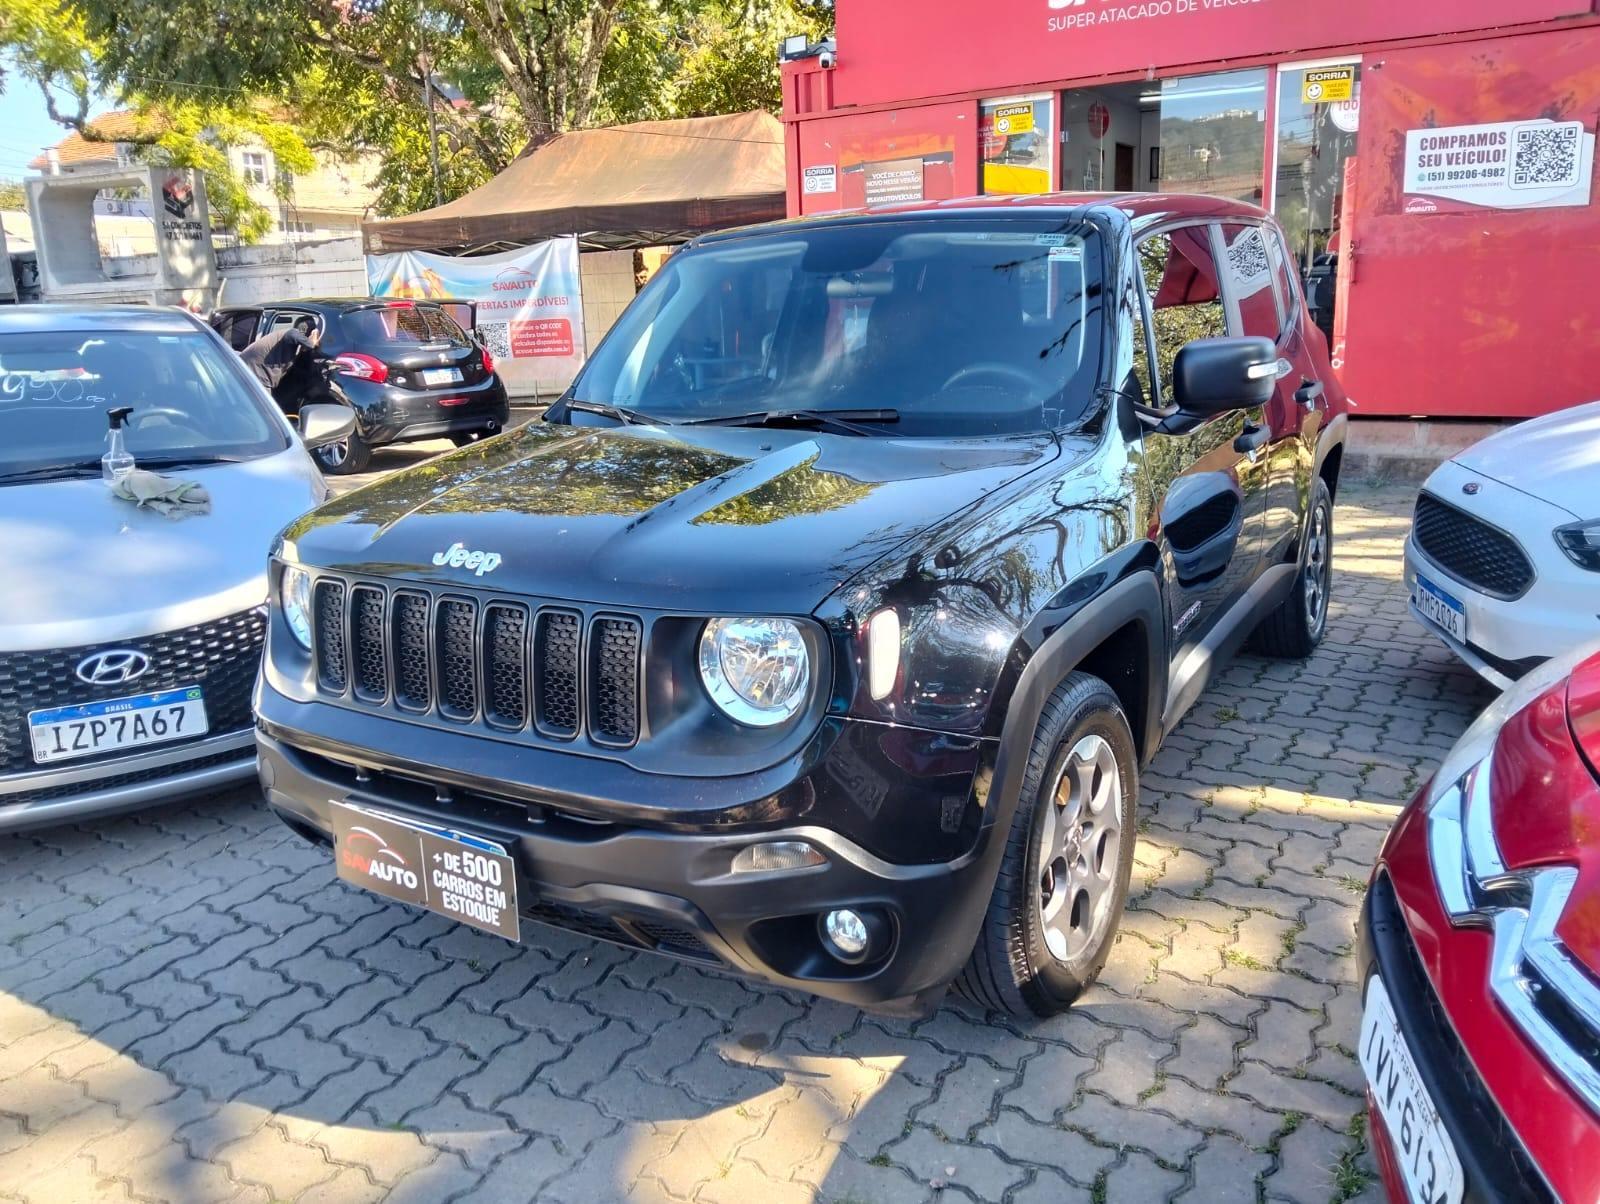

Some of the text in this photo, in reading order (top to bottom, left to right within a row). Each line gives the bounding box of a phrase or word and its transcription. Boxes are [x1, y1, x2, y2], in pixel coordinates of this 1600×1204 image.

[1047, 12, 1096, 32] SUPER
[1098, 3, 1173, 25] ATACADO
[1176, 0, 1198, 13] DE
[1308, 71, 1348, 82] SORRIA
[997, 106, 1029, 117] SORRIA
[1420, 131, 1507, 151] COMPRAMOS
[1418, 148, 1507, 168] SEU VEÍCULO!
[806, 168, 833, 176] SORRIA
[1427, 167, 1506, 182] (51) 99206-4982
[492, 280, 539, 292] SAVAUTO
[476, 301, 509, 311] FERTAS
[432, 542, 502, 577] Jeep
[105, 703, 133, 714] BRASIL
[51, 706, 186, 754] IZP7A67
[37, 749, 48, 760] BR
[343, 850, 418, 890] SAVAUTO
[444, 852, 462, 874] DE
[462, 850, 502, 887] 500
[432, 869, 507, 910] CARROS EM
[442, 890, 501, 927] ESTOQUE
